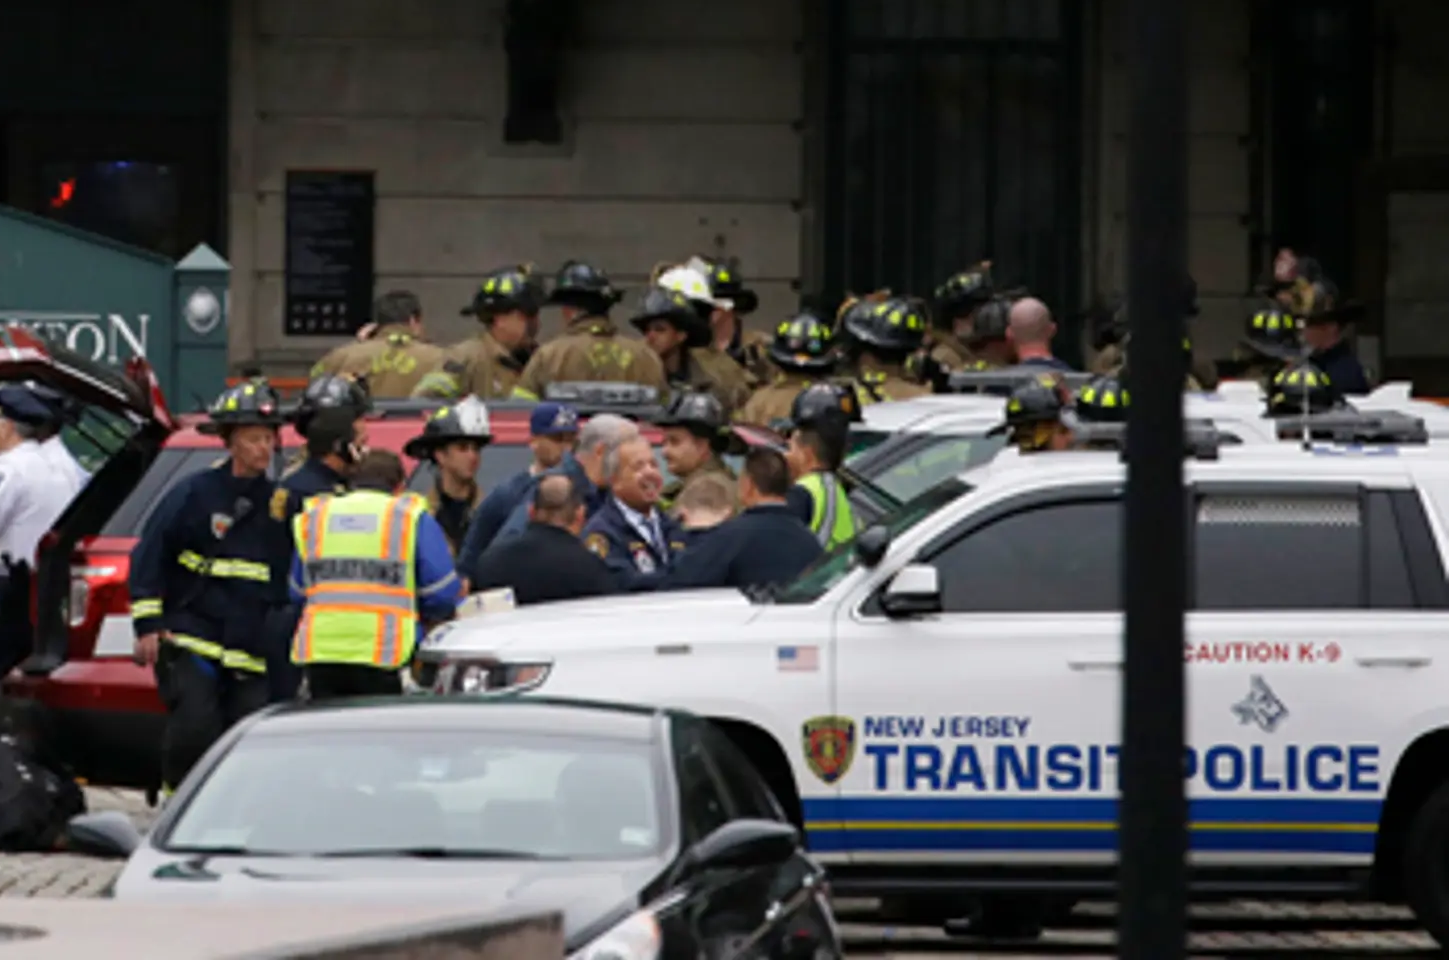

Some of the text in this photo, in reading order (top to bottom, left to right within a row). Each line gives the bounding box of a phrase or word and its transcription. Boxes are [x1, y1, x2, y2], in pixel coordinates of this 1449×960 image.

[1296, 641, 1343, 664] K-9
[864, 716, 1032, 739] NEW JERSEY
